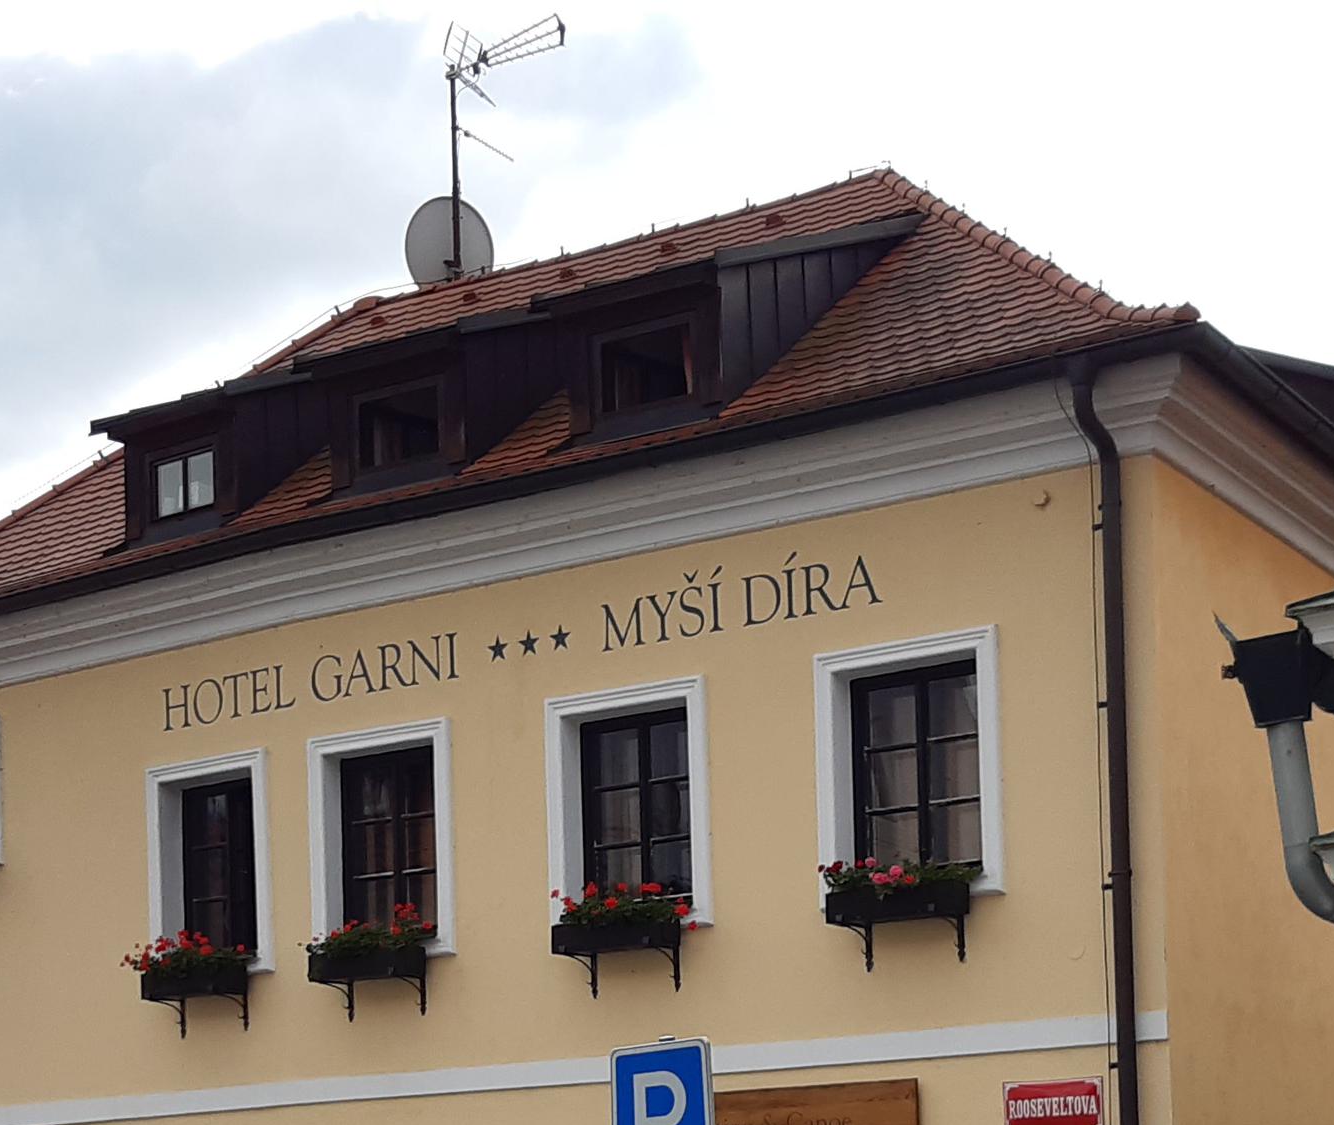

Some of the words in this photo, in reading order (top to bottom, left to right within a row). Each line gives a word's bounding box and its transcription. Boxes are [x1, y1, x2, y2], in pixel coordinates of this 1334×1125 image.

[161, 664, 296, 732] HOTEL
[310, 632, 460, 702] GARNI
[601, 565, 724, 652] MYŠÍ
[741, 551, 883, 627] DÍRA
[1008, 1095, 1098, 1119] ROOSEVELTOVA
